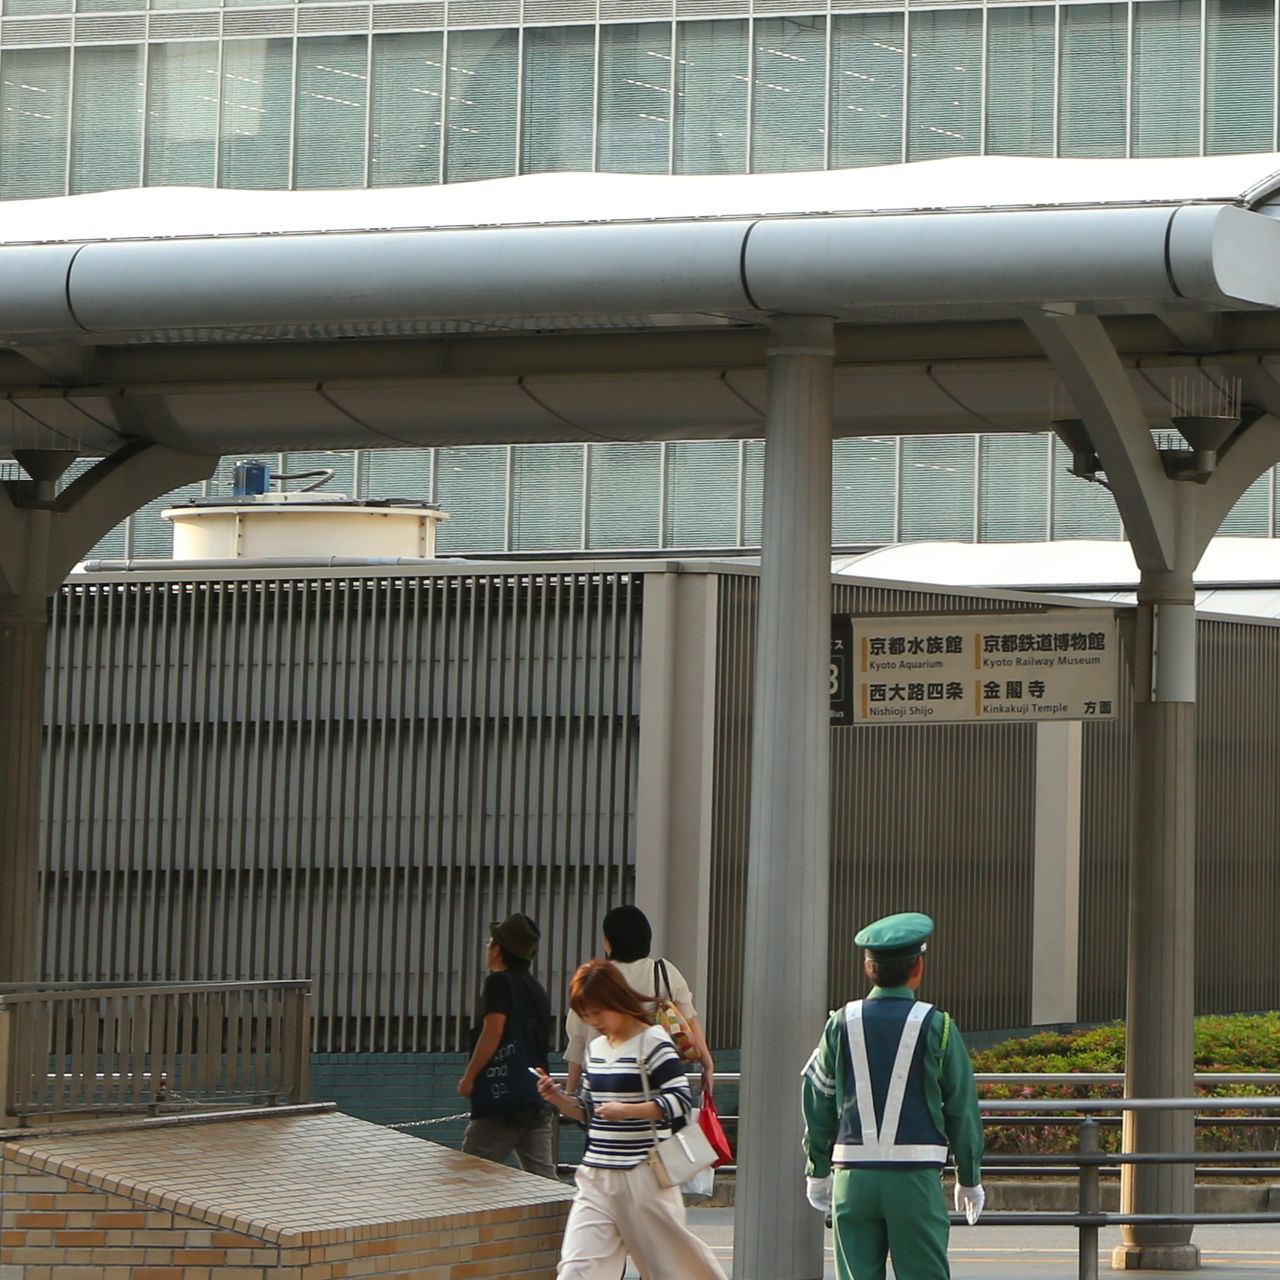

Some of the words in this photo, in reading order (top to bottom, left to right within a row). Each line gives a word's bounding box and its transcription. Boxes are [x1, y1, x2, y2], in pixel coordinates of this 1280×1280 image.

[869, 636, 963, 656] 京都水族館
[983, 632, 1106, 653] 京都鉄道博物館
[869, 660, 896, 671] Kyoto
[899, 659, 943, 671] Aquarium
[983, 658, 1013, 669] Kyoto
[1016, 656, 1055, 667] Railway
[1058, 655, 1100, 665] Museum
[869, 681, 963, 702] 西大路四条
[983, 680, 1046, 699] 金閣寺
[869, 706, 906, 717] Nishioji
[909, 706, 934, 717] Shijo
[983, 703, 1029, 714] Kinkakuji
[1032, 702, 1068, 714] Temple
[1083, 700, 1112, 715] 方面
